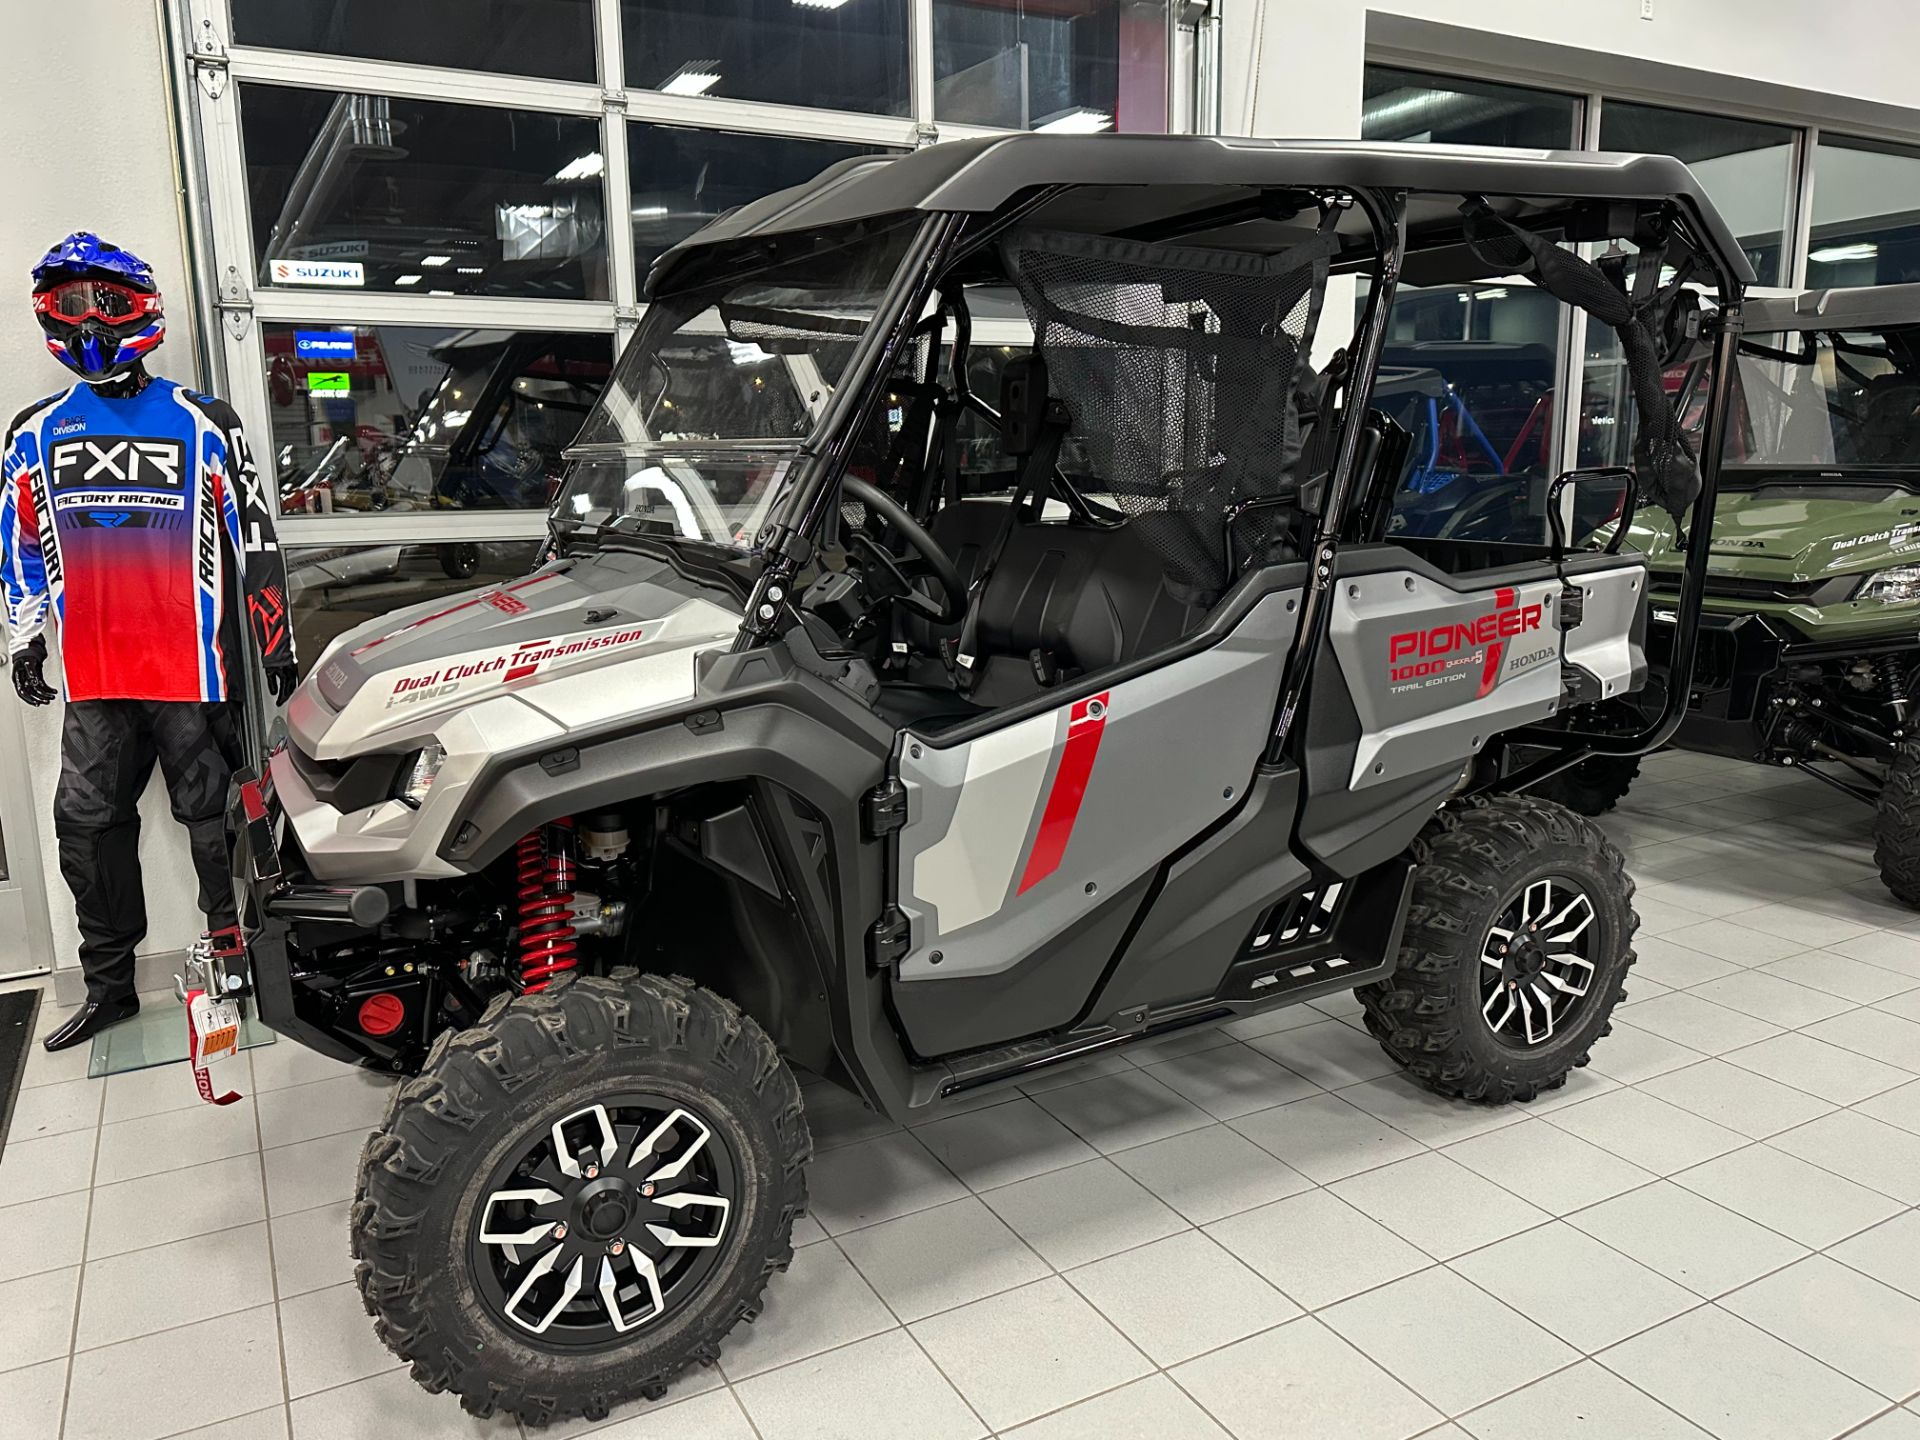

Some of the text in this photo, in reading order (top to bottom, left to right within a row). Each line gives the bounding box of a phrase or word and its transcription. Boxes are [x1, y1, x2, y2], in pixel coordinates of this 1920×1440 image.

[308, 244, 366, 258] SUZUKI
[296, 267, 359, 279] SUZUKI
[53, 422, 87, 436] DIVISION
[53, 440, 179, 485] FXR
[57, 494, 179, 508] FACTORY RACING
[29, 468, 63, 585] FACTORY
[199, 466, 215, 590] RACING
[1831, 540, 1857, 551] Dual
[1857, 530, 1891, 545] Clutch
[1390, 603, 1542, 664] PIONEER
[393, 629, 643, 694] Dual Clutch Transmission
[1389, 659, 1446, 682] 1000
[1510, 646, 1556, 671] HONDA
[1390, 672, 1467, 694] TRAIL EDITION
[385, 682, 461, 709] i-4WD
